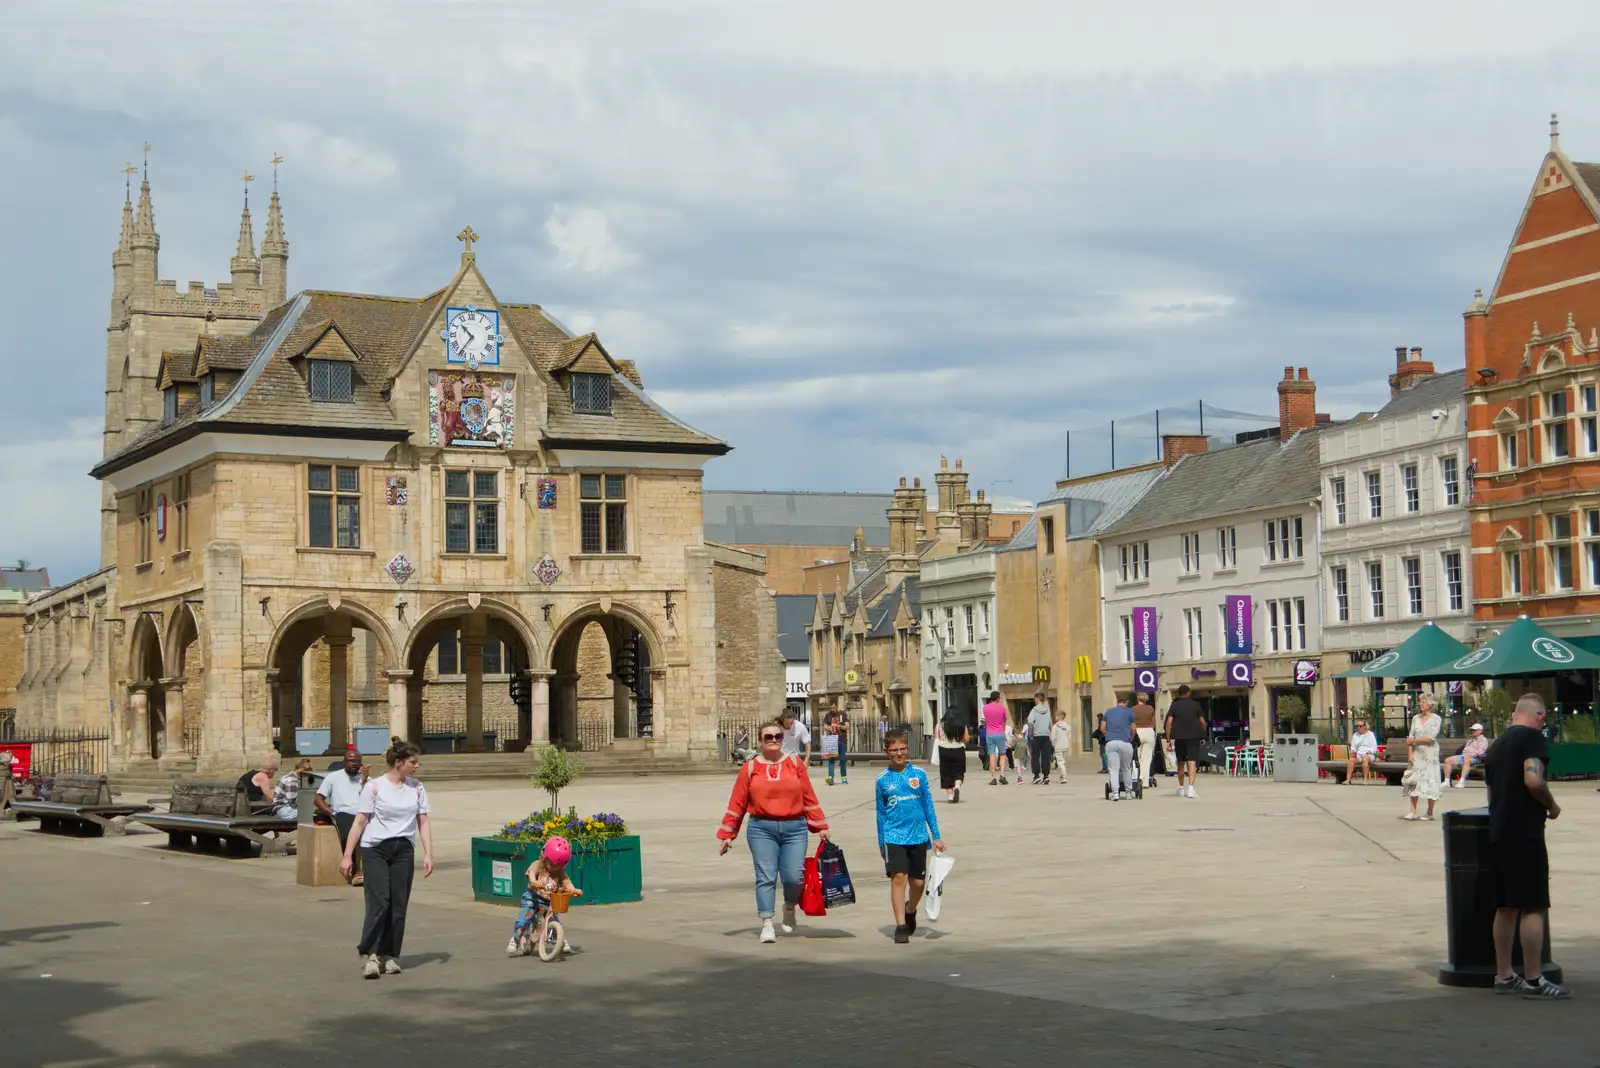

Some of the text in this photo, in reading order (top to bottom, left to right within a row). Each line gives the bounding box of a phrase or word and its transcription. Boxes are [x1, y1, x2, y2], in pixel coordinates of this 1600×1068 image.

[1142, 611, 1150, 656] Queensgate
[1236, 600, 1244, 648] Queensgate
[1348, 650, 1374, 663] TACO
